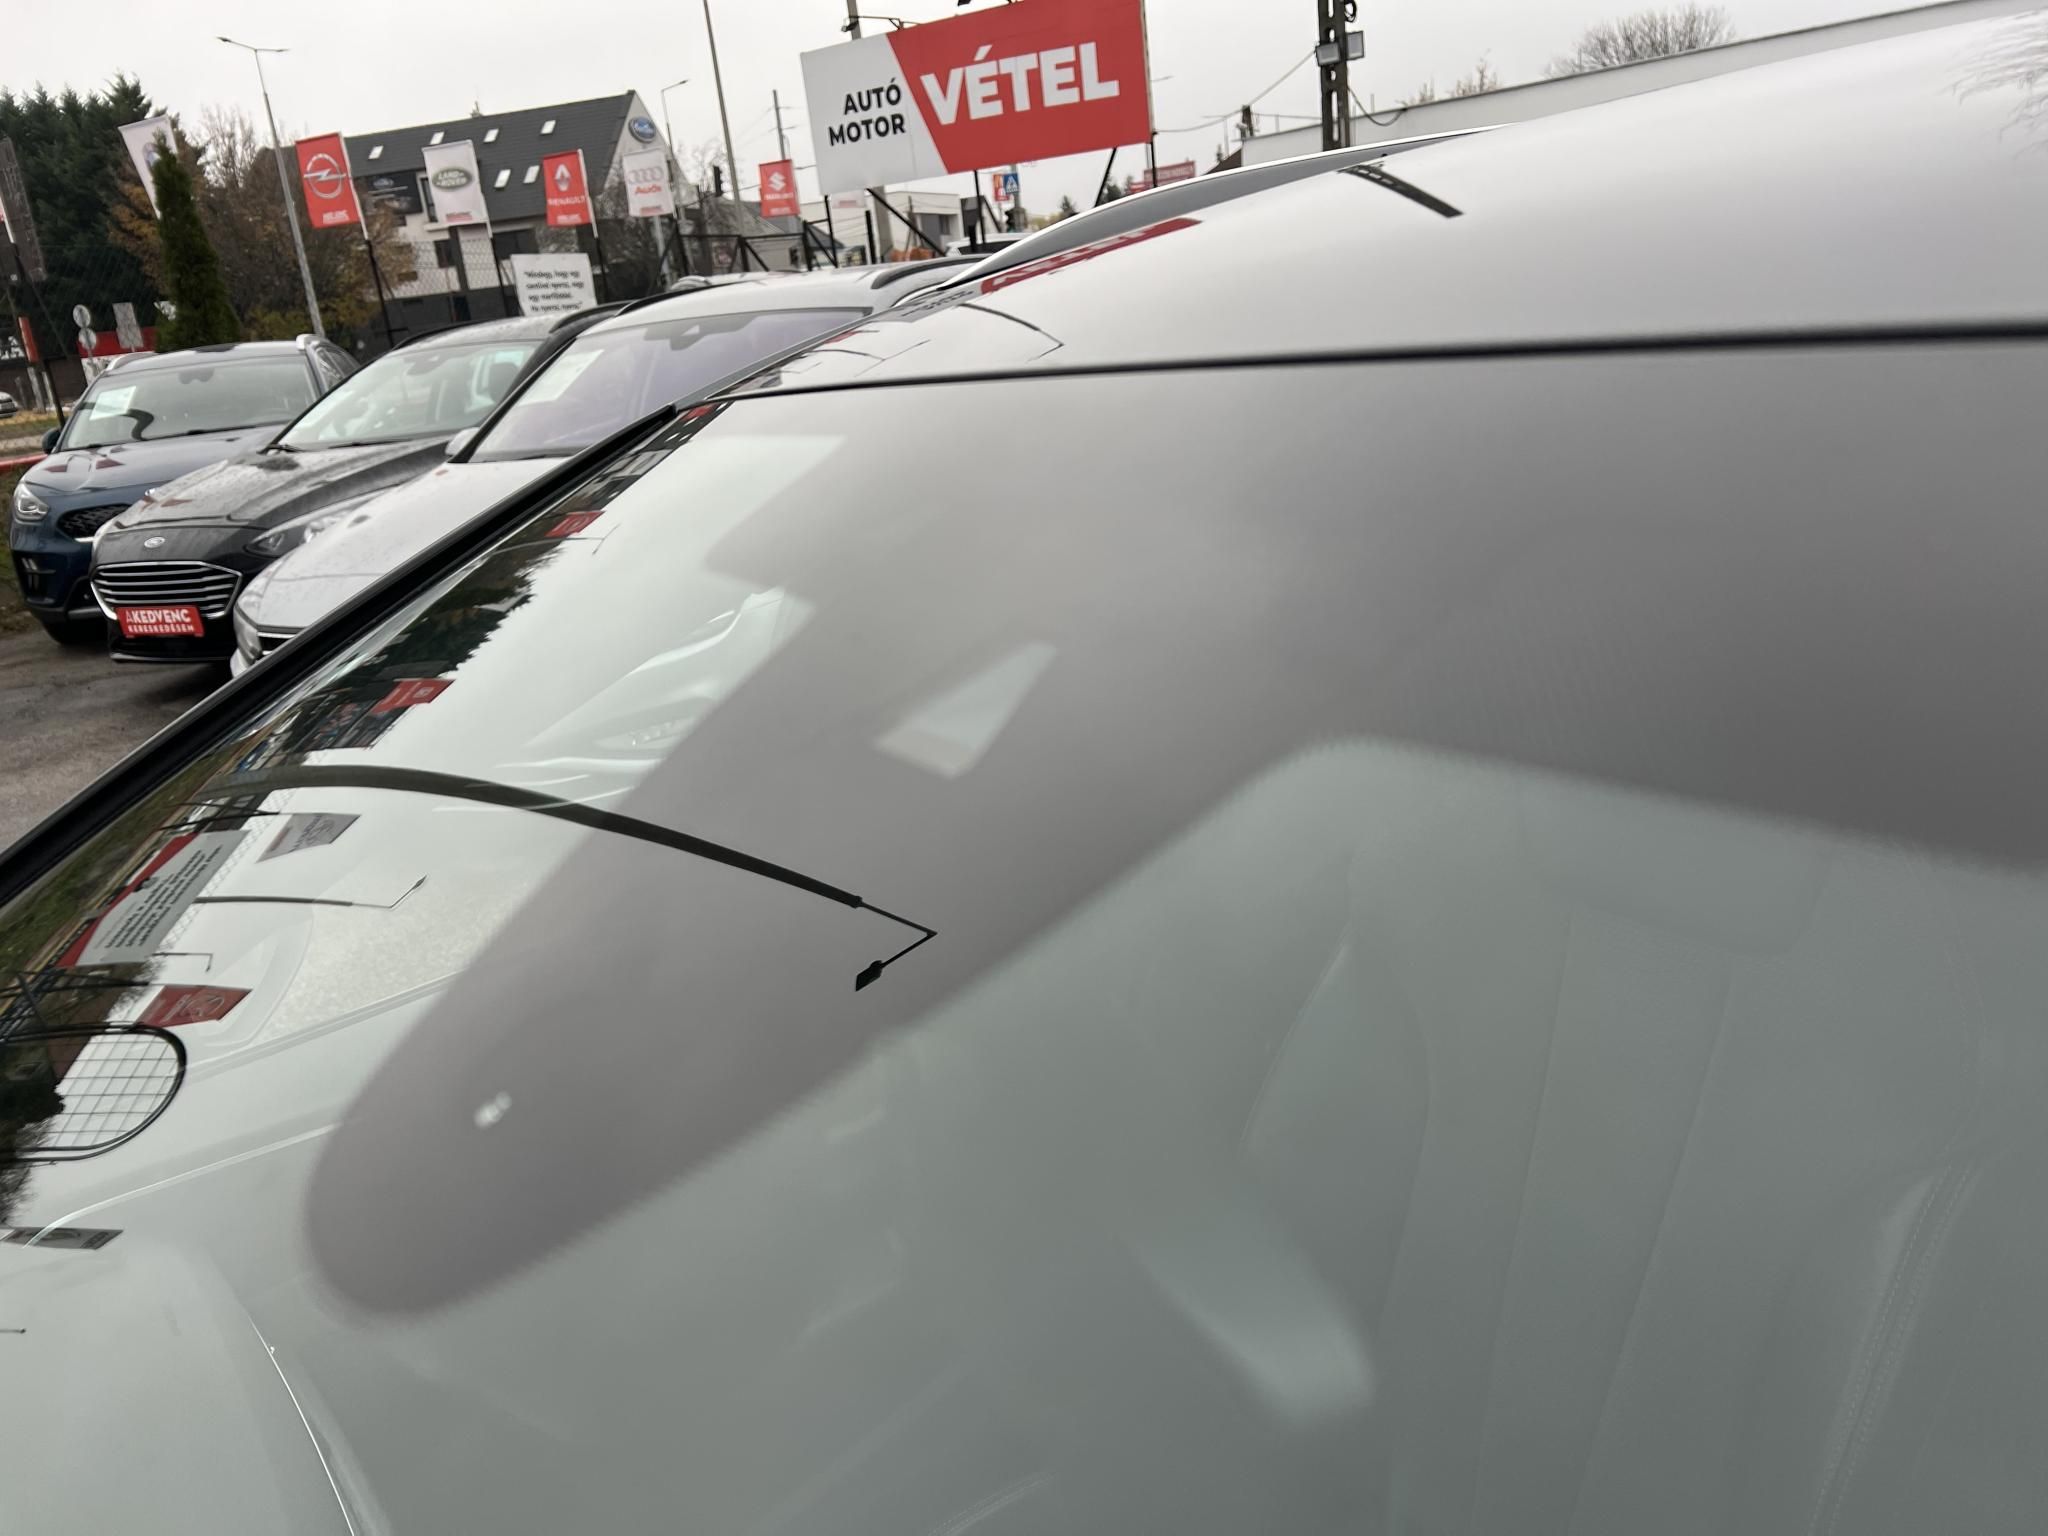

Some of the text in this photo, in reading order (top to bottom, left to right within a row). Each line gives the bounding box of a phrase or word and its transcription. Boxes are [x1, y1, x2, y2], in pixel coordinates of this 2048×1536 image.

[843, 78, 902, 115] AUTÓ
[920, 42, 1120, 126] VÉTEL
[828, 113, 906, 147] MOTOR
[126, 608, 192, 624] AKEDVENC
